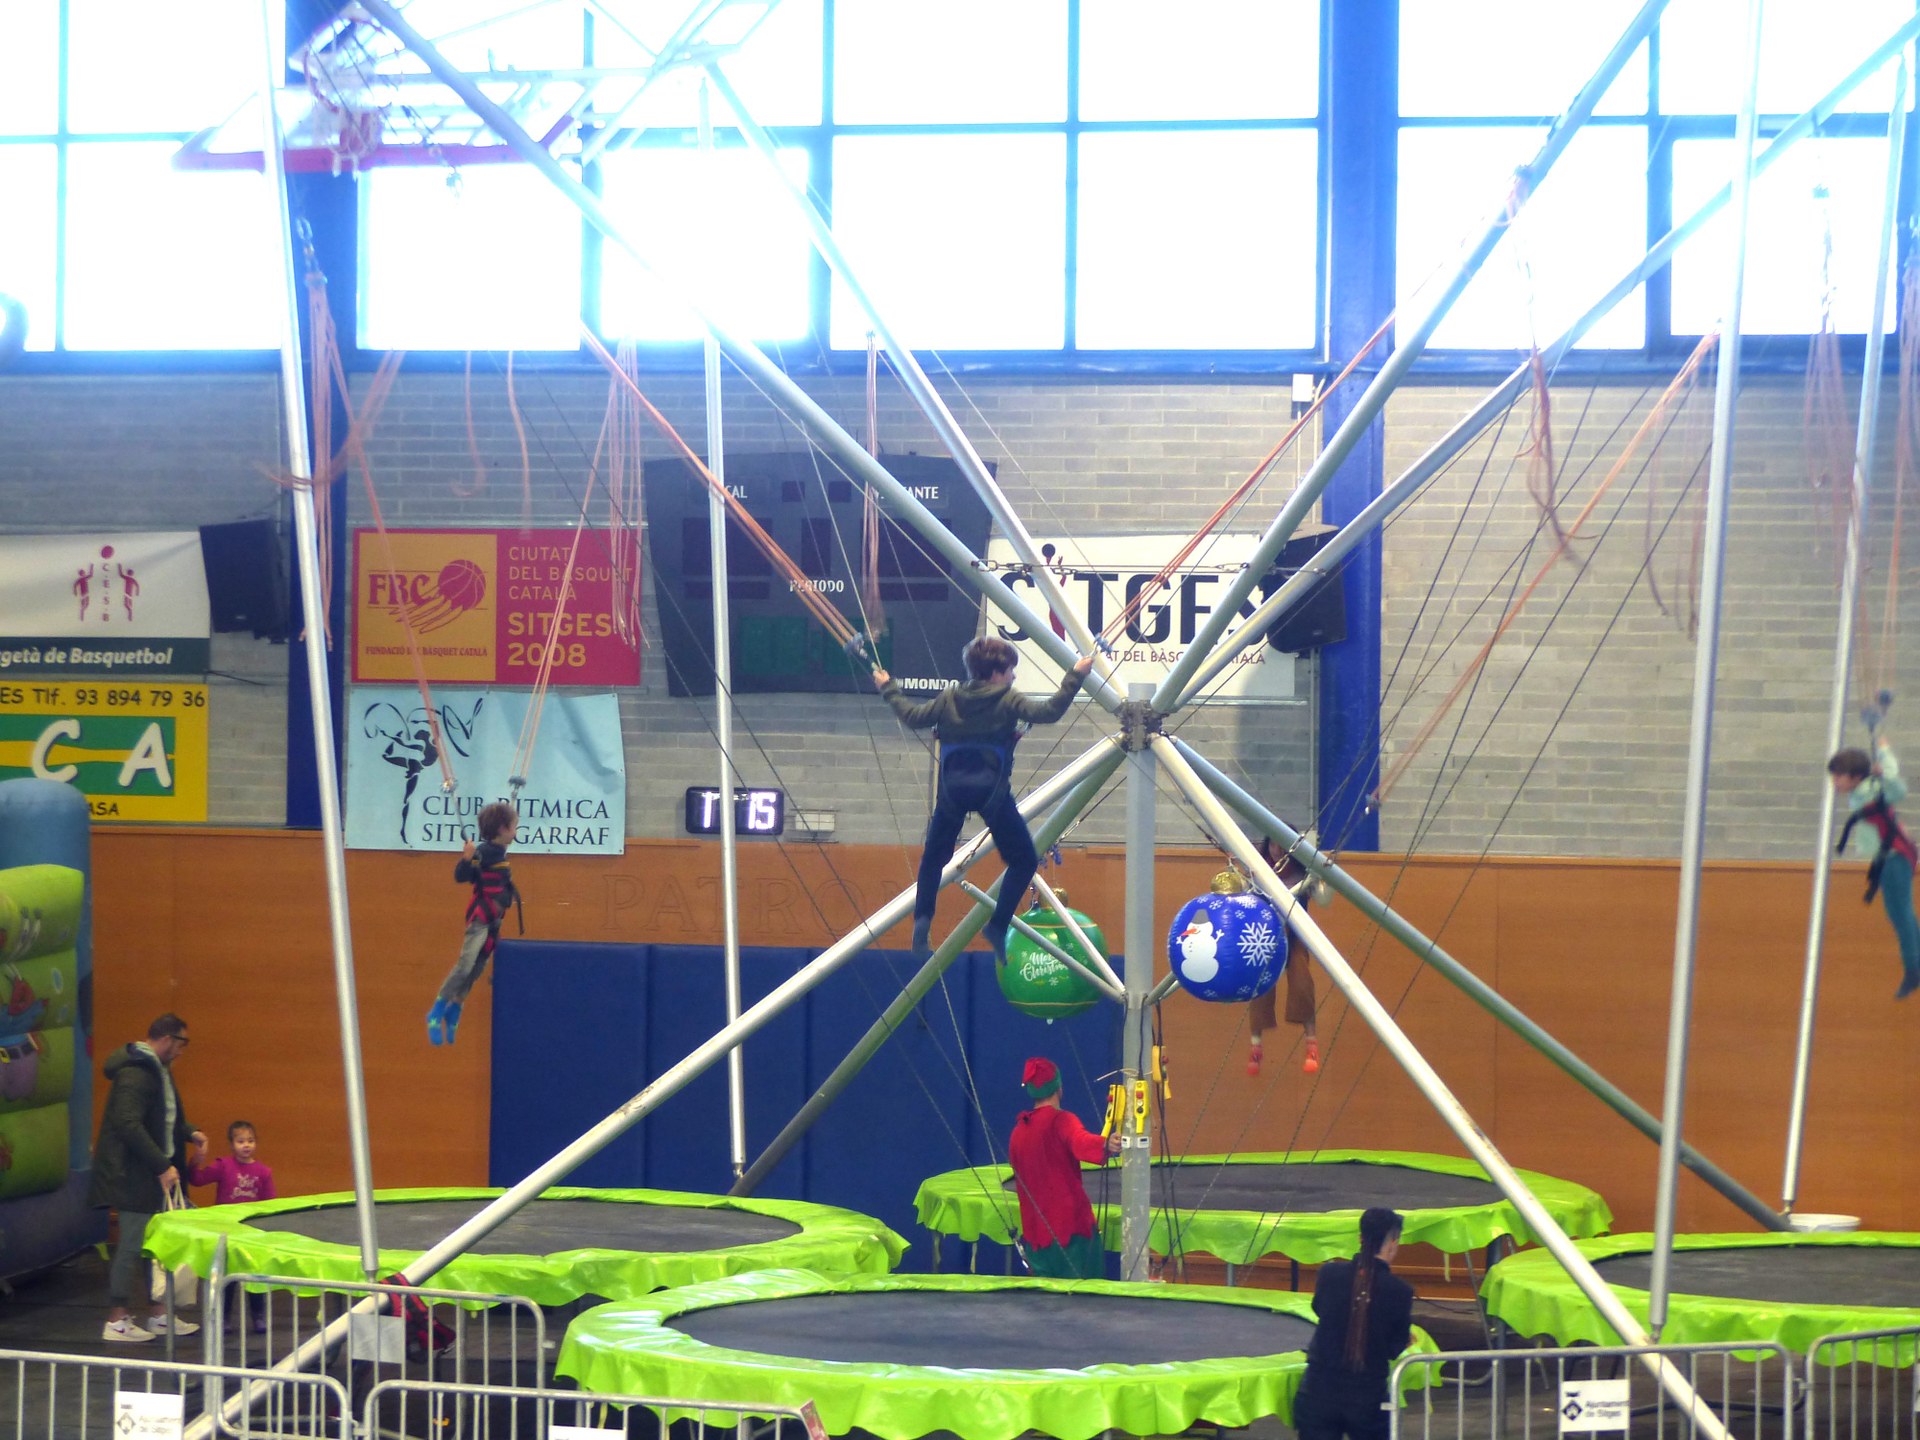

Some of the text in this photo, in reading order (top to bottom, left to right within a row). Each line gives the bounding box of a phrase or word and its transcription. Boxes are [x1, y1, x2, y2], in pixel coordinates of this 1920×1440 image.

[509, 546, 572, 561] CIUTAT
[509, 566, 542, 581] DEL
[507, 611, 613, 637] SITGES
[0, 647, 173, 668] getà de Basquetbol
[507, 642, 587, 667] 2008
[1124, 651, 1146, 663] DEL
[76, 689, 98, 706] 93
[107, 690, 142, 707] 894
[150, 690, 173, 707] 79
[183, 691, 205, 707] 36
[514, 825, 610, 846] GARRAF
